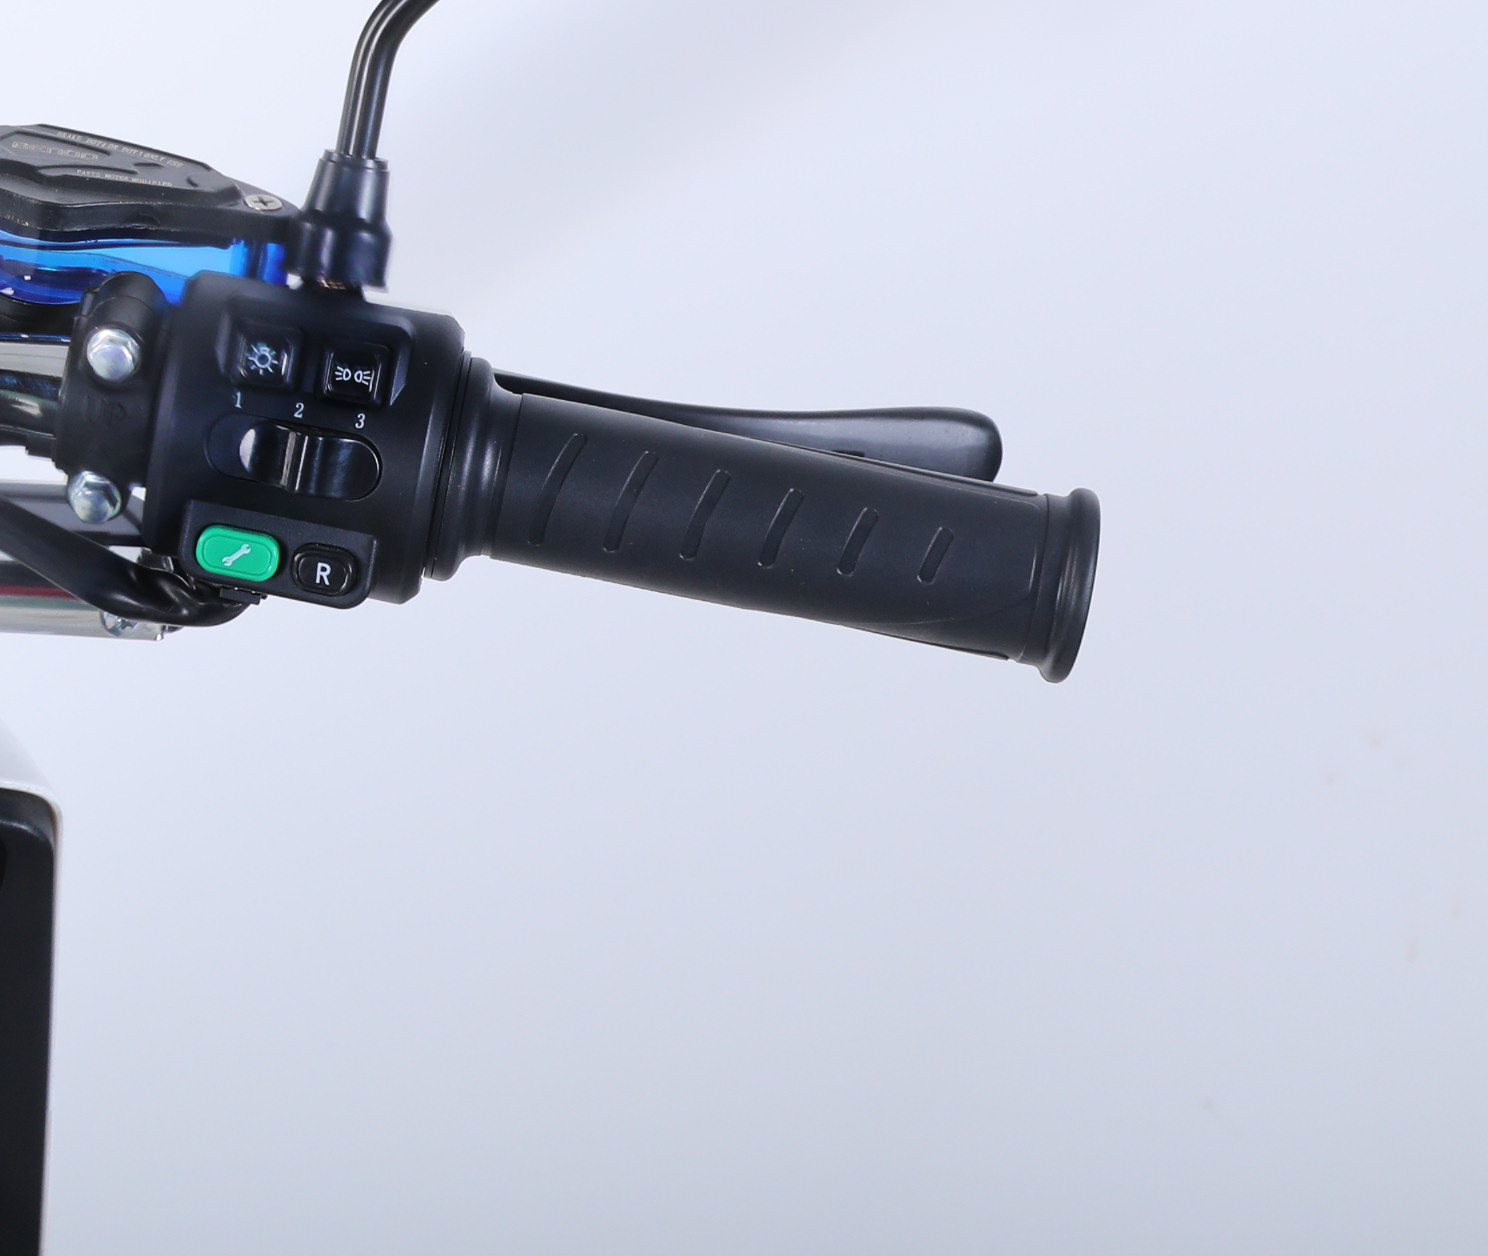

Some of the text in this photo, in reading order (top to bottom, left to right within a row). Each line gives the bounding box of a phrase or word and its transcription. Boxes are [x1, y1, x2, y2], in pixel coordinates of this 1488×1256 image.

[56, 130, 83, 143] BRAKE
[76, 168, 101, 178] PARTS
[104, 172, 129, 182] MOTOR
[234, 390, 243, 410] 1
[293, 401, 305, 420] 2
[355, 412, 366, 430] 3
[314, 562, 332, 587] R
